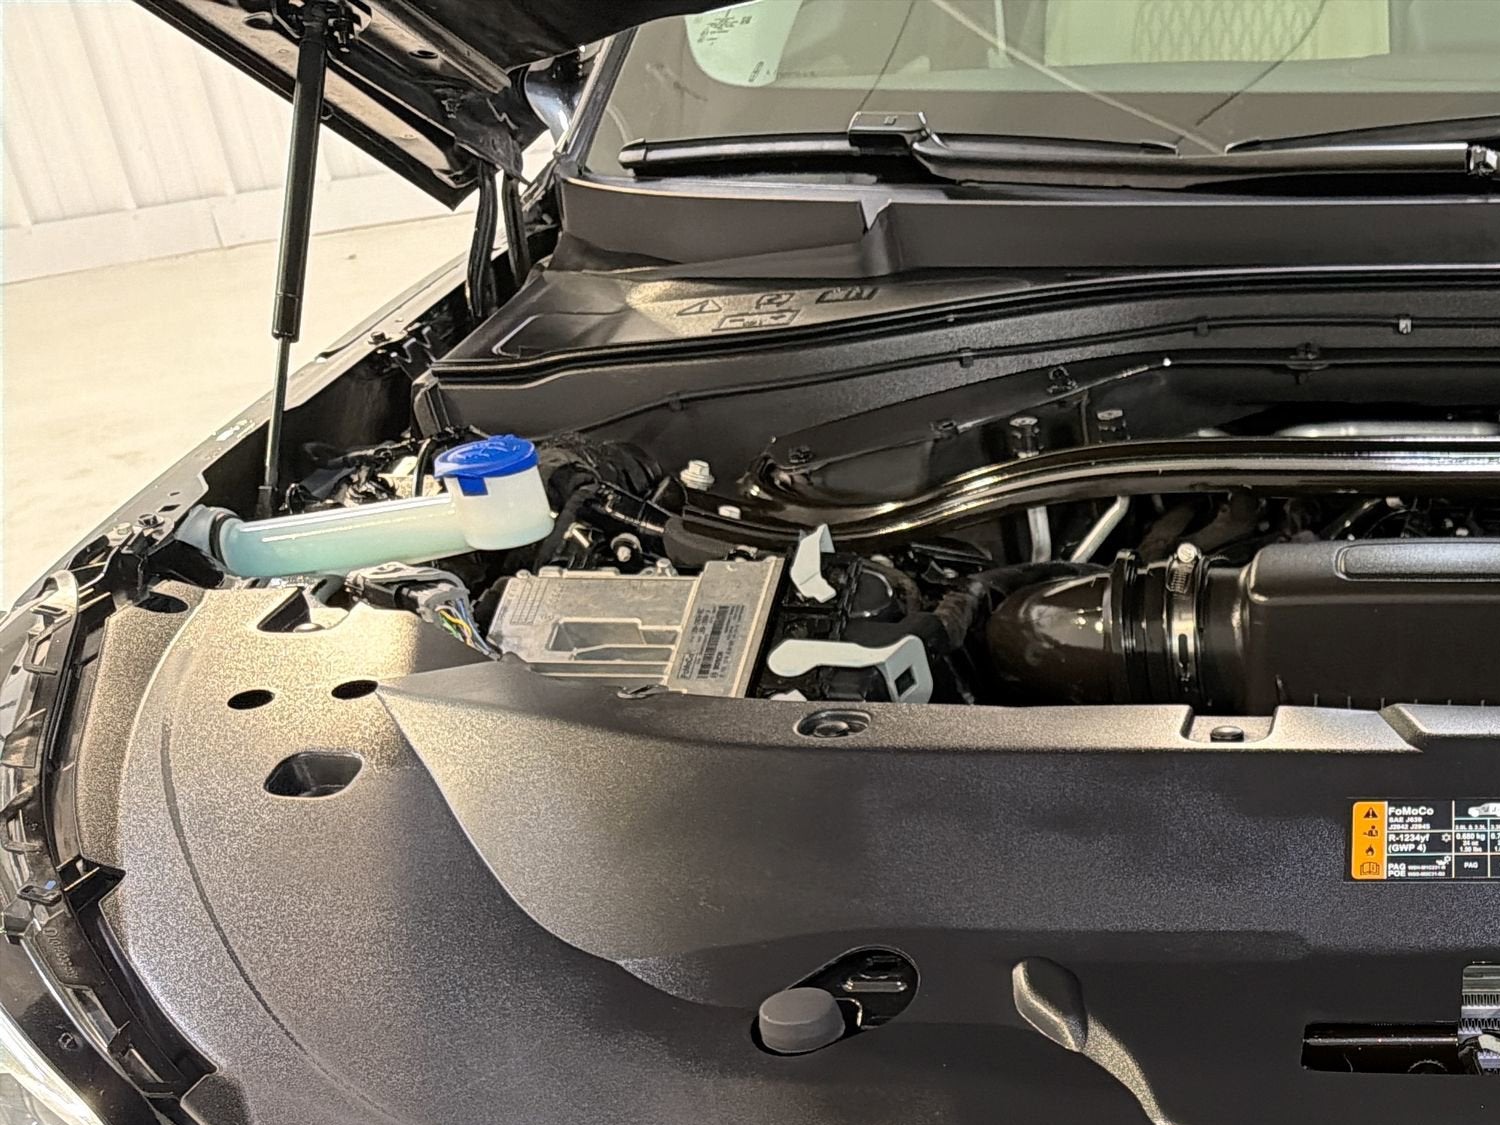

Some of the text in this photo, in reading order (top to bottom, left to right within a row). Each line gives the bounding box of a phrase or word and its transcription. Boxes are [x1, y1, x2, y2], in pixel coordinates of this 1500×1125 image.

[1388, 806, 1434, 816] FoMoCo
[1388, 833, 1430, 843] R-1234yf
[1476, 833, 1486, 841] kg
[1388, 843, 1427, 854] (GWP 4)
